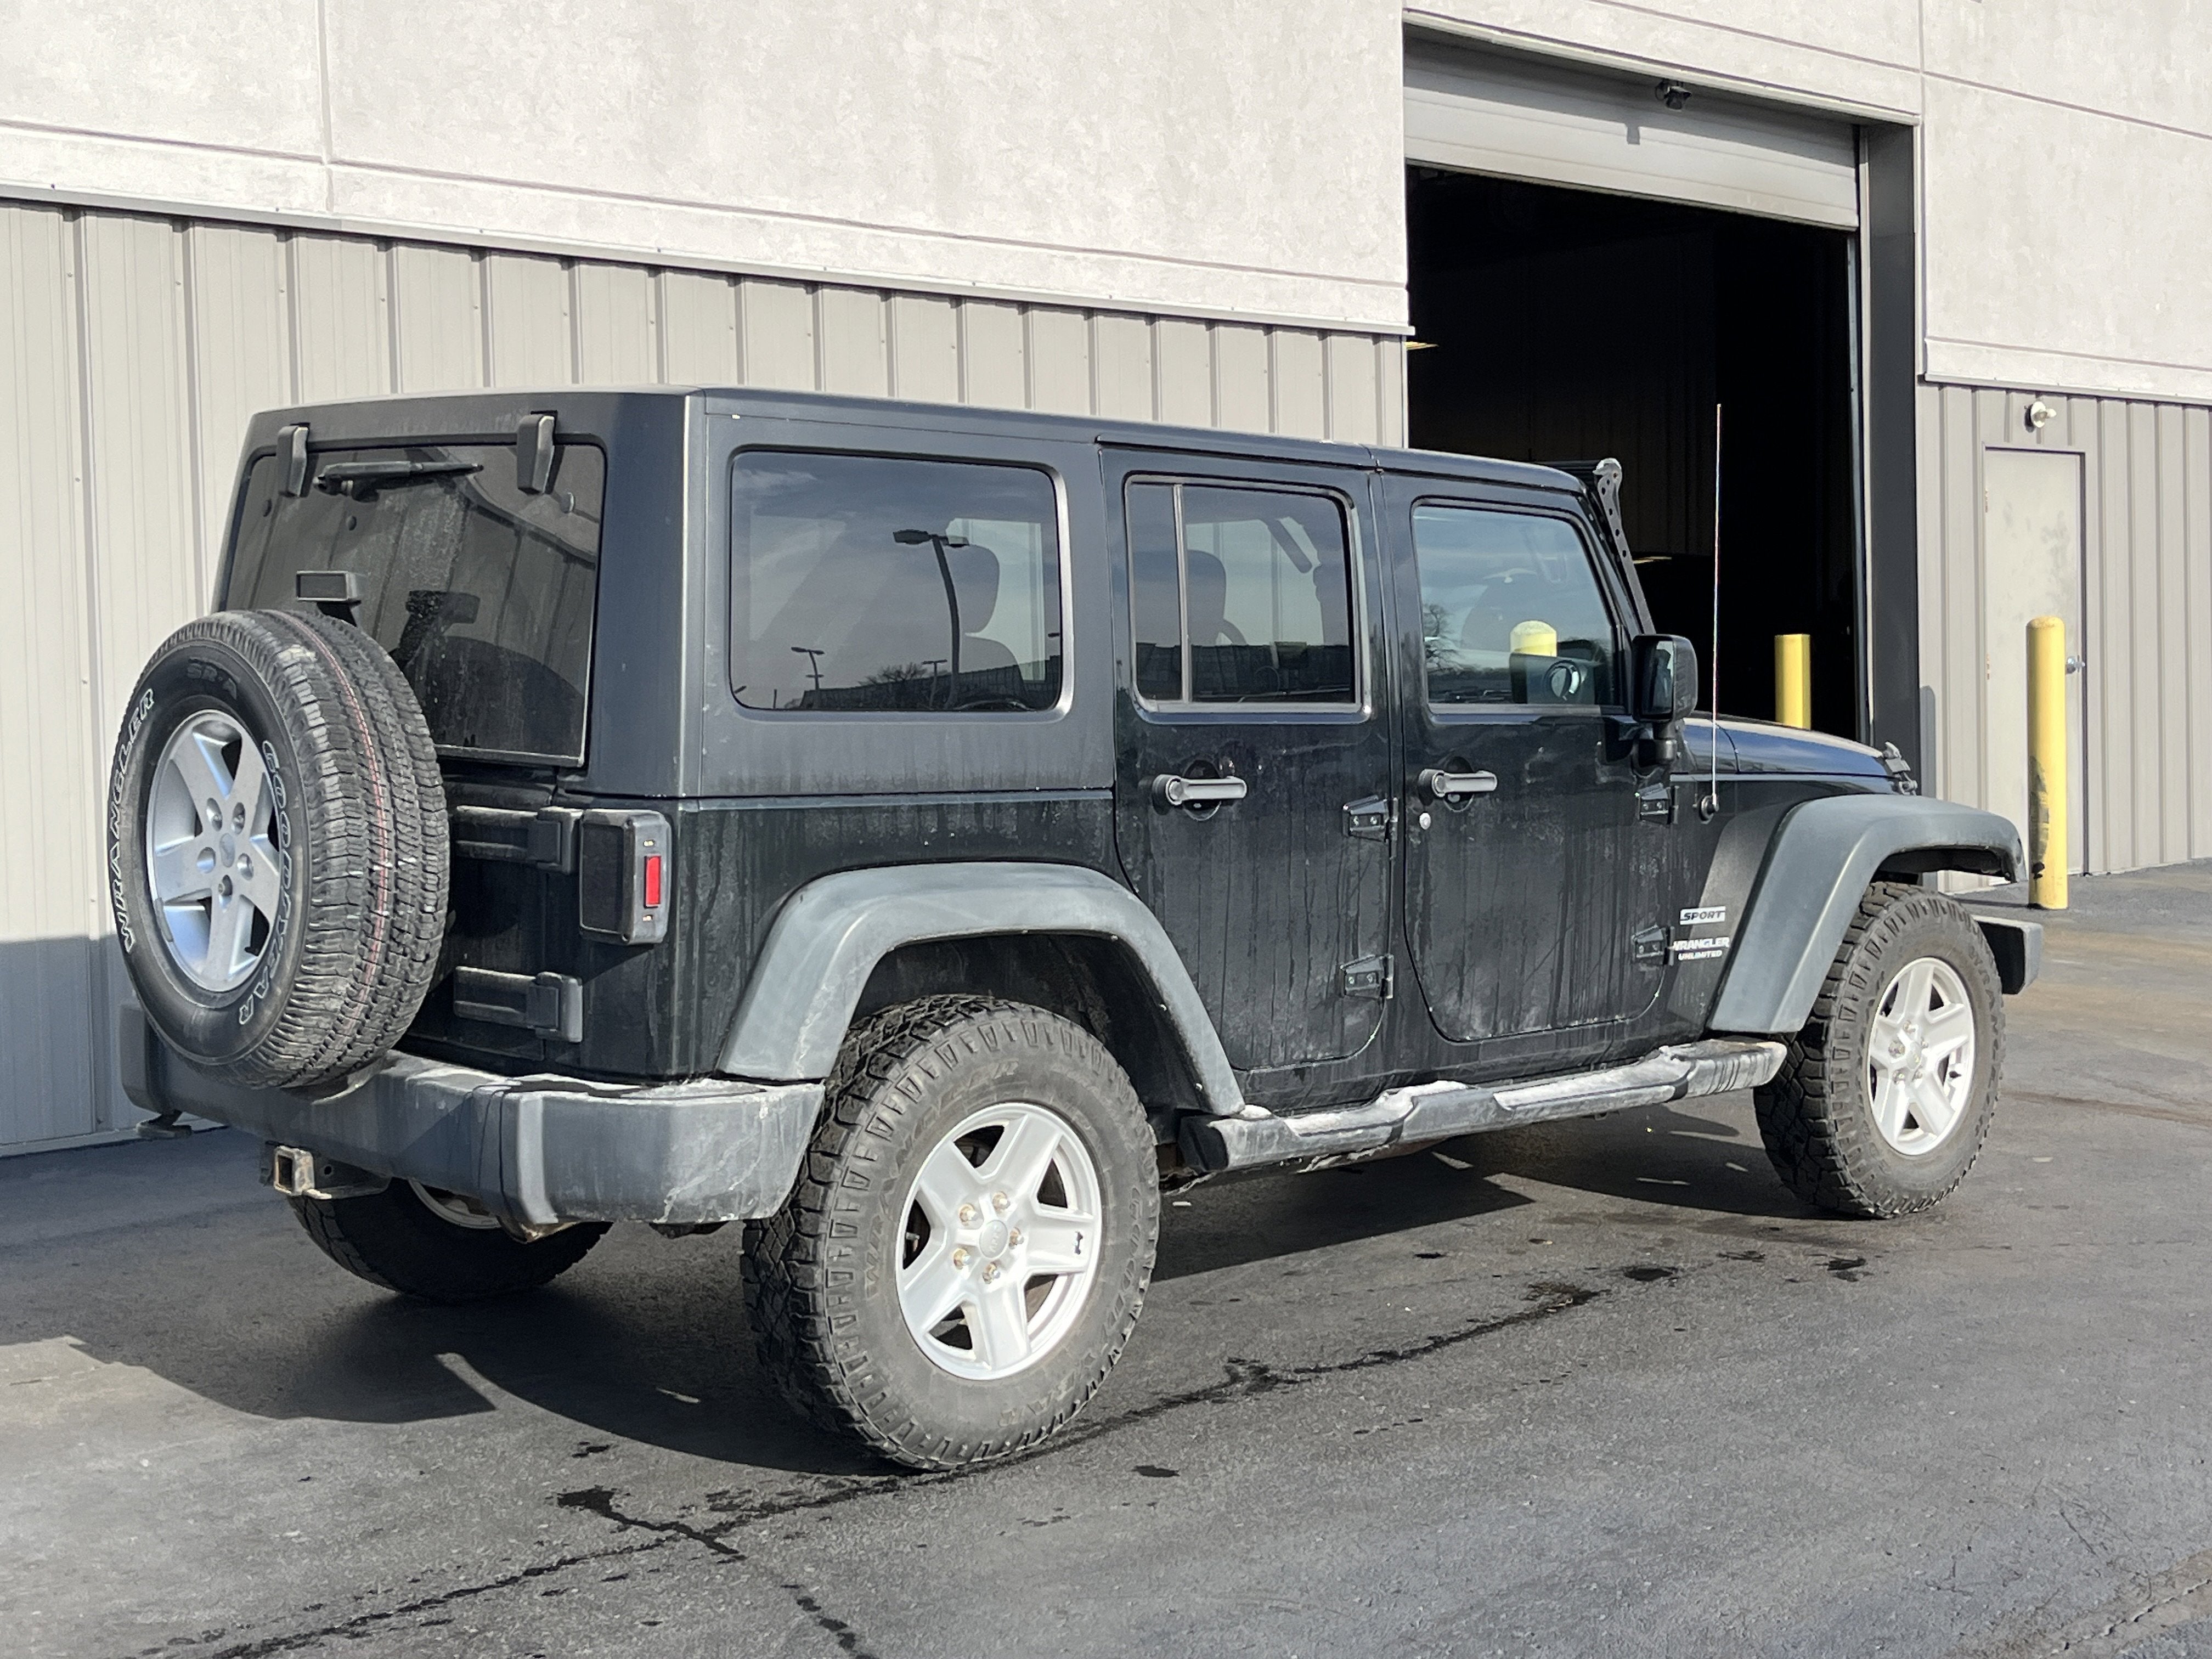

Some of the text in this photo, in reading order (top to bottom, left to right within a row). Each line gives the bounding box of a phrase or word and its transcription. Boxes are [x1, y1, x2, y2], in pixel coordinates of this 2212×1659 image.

[110, 689, 155, 953] WRANGLER
[238, 740, 292, 1025] GOODYEAR
[1683, 911, 1724, 921] SPORT
